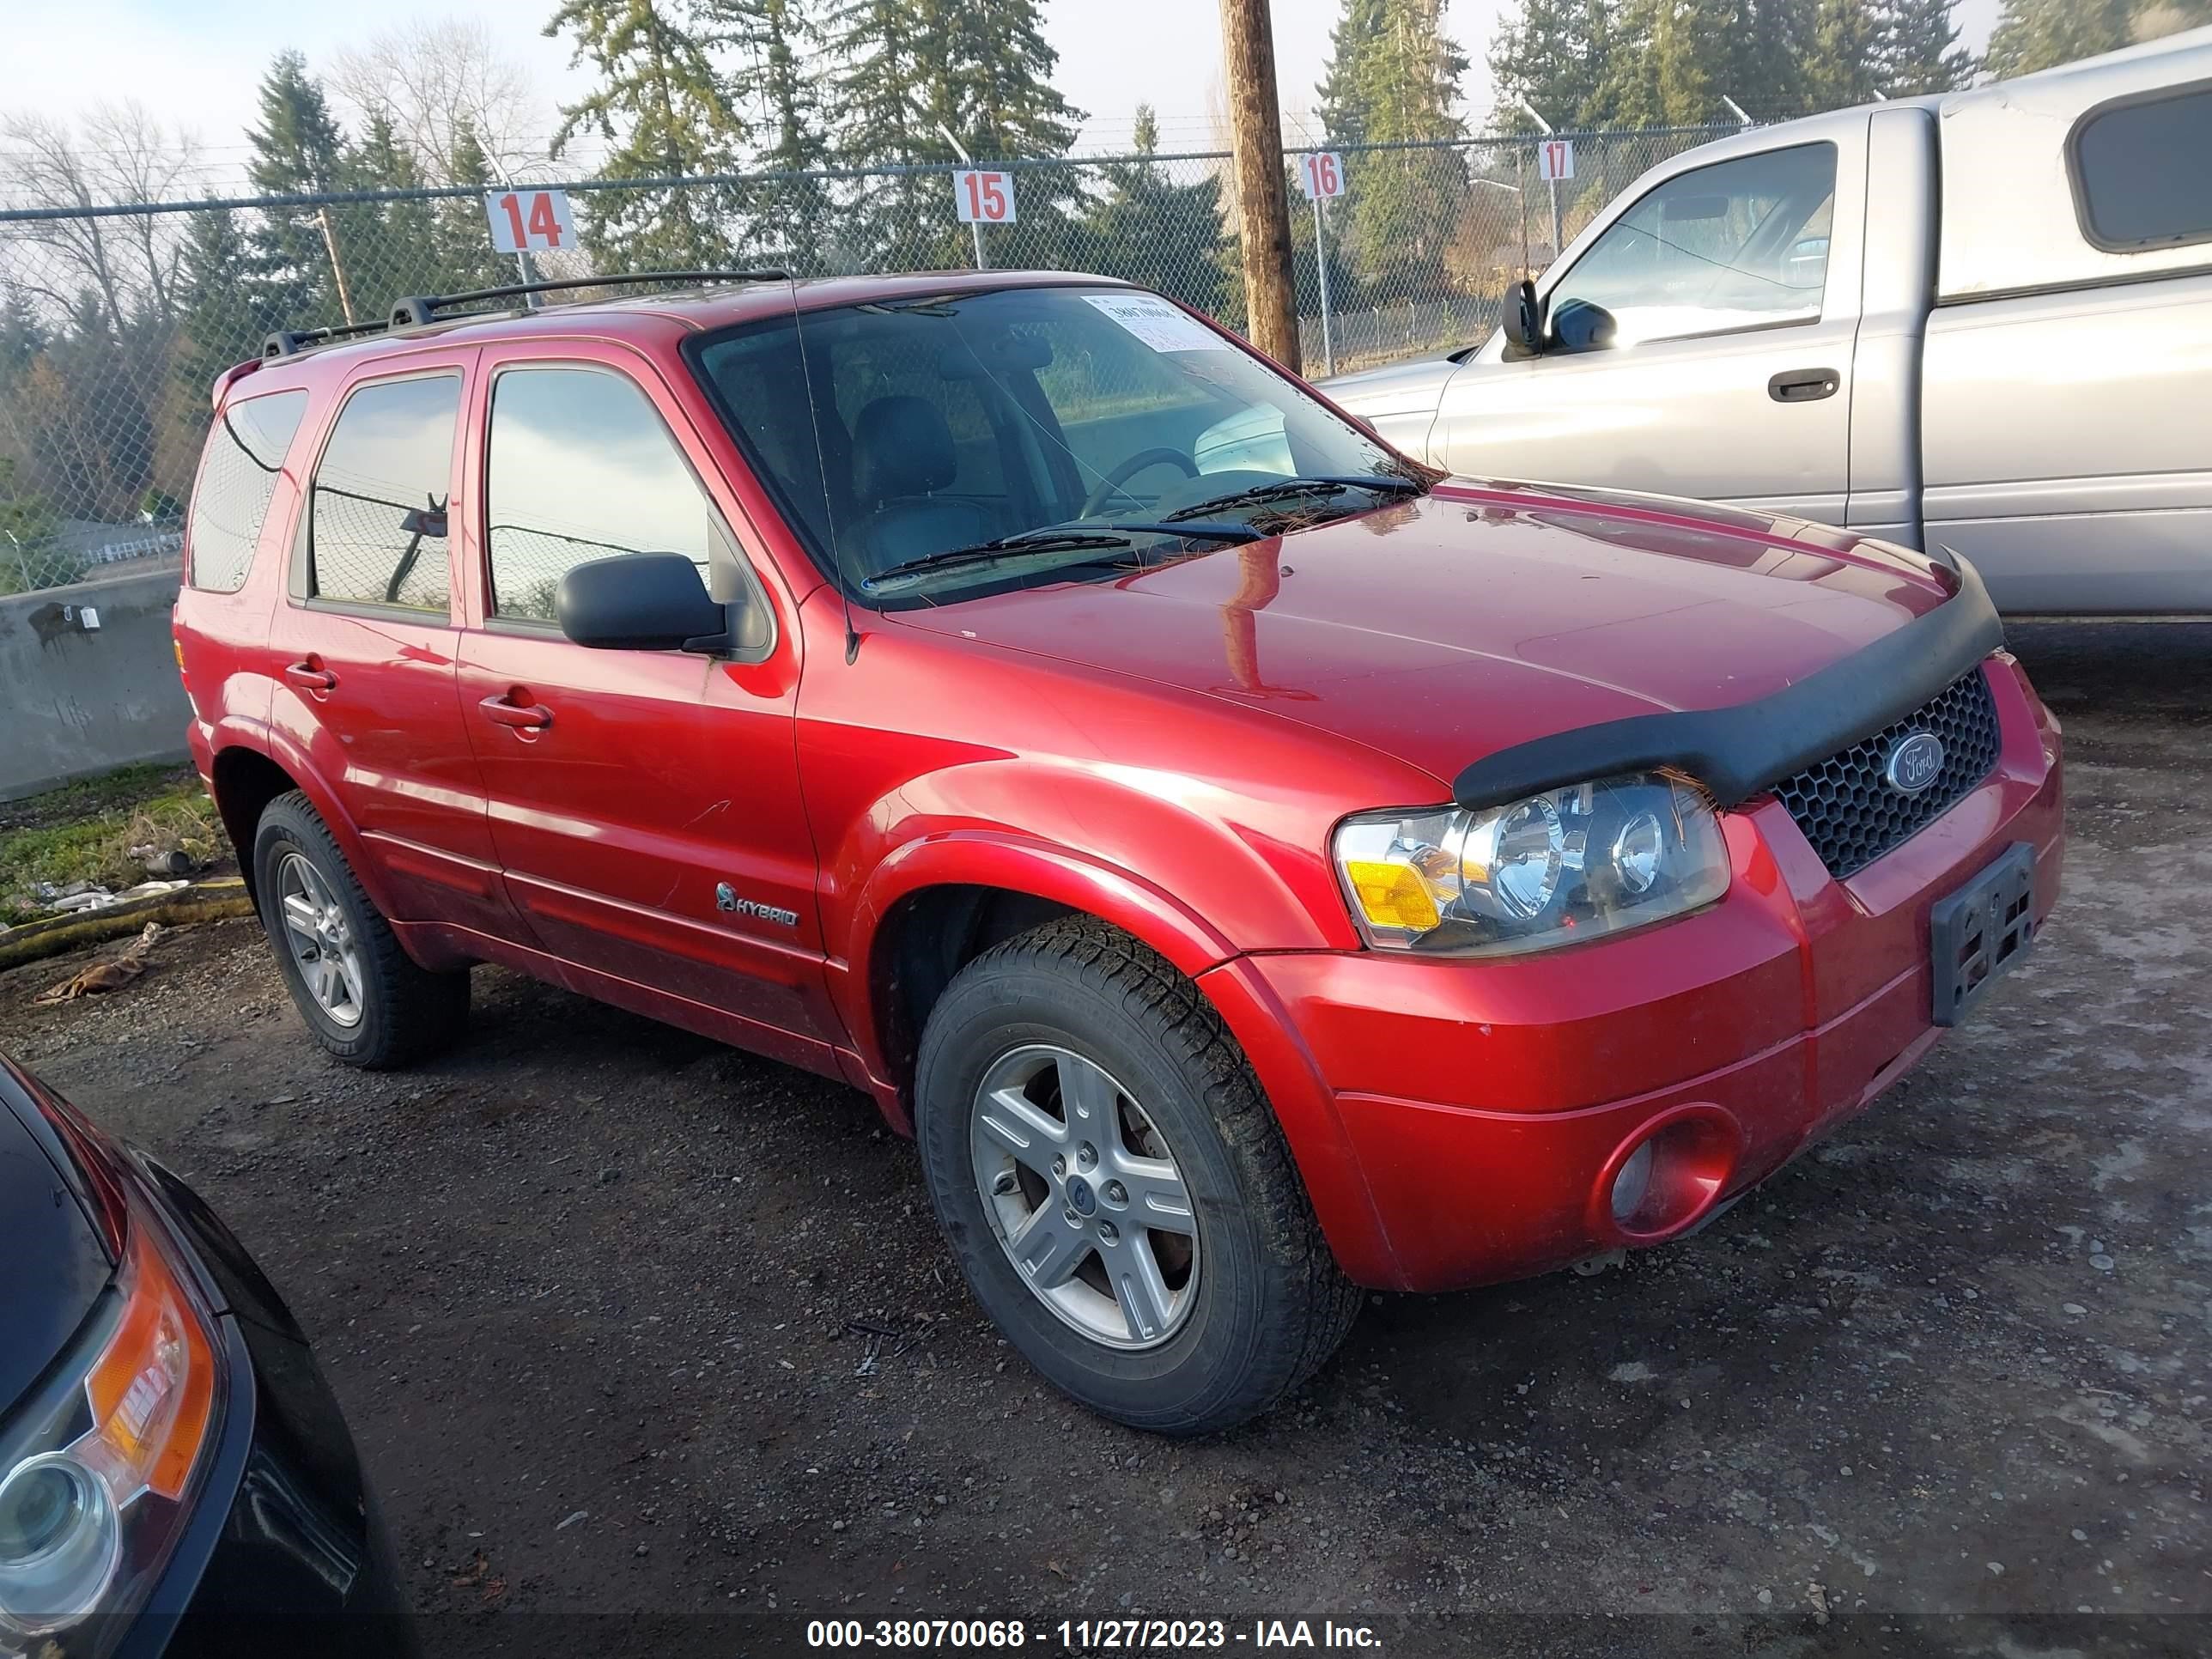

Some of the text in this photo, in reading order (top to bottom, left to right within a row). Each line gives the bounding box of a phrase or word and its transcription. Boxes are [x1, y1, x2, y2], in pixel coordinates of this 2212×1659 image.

[1308, 155, 1337, 196] 16
[1547, 143, 1565, 178] 17
[964, 173, 1006, 220] 15
[500, 192, 563, 249] 14
[1905, 744, 1936, 781] Ford
[736, 898, 799, 926] HYBRID
